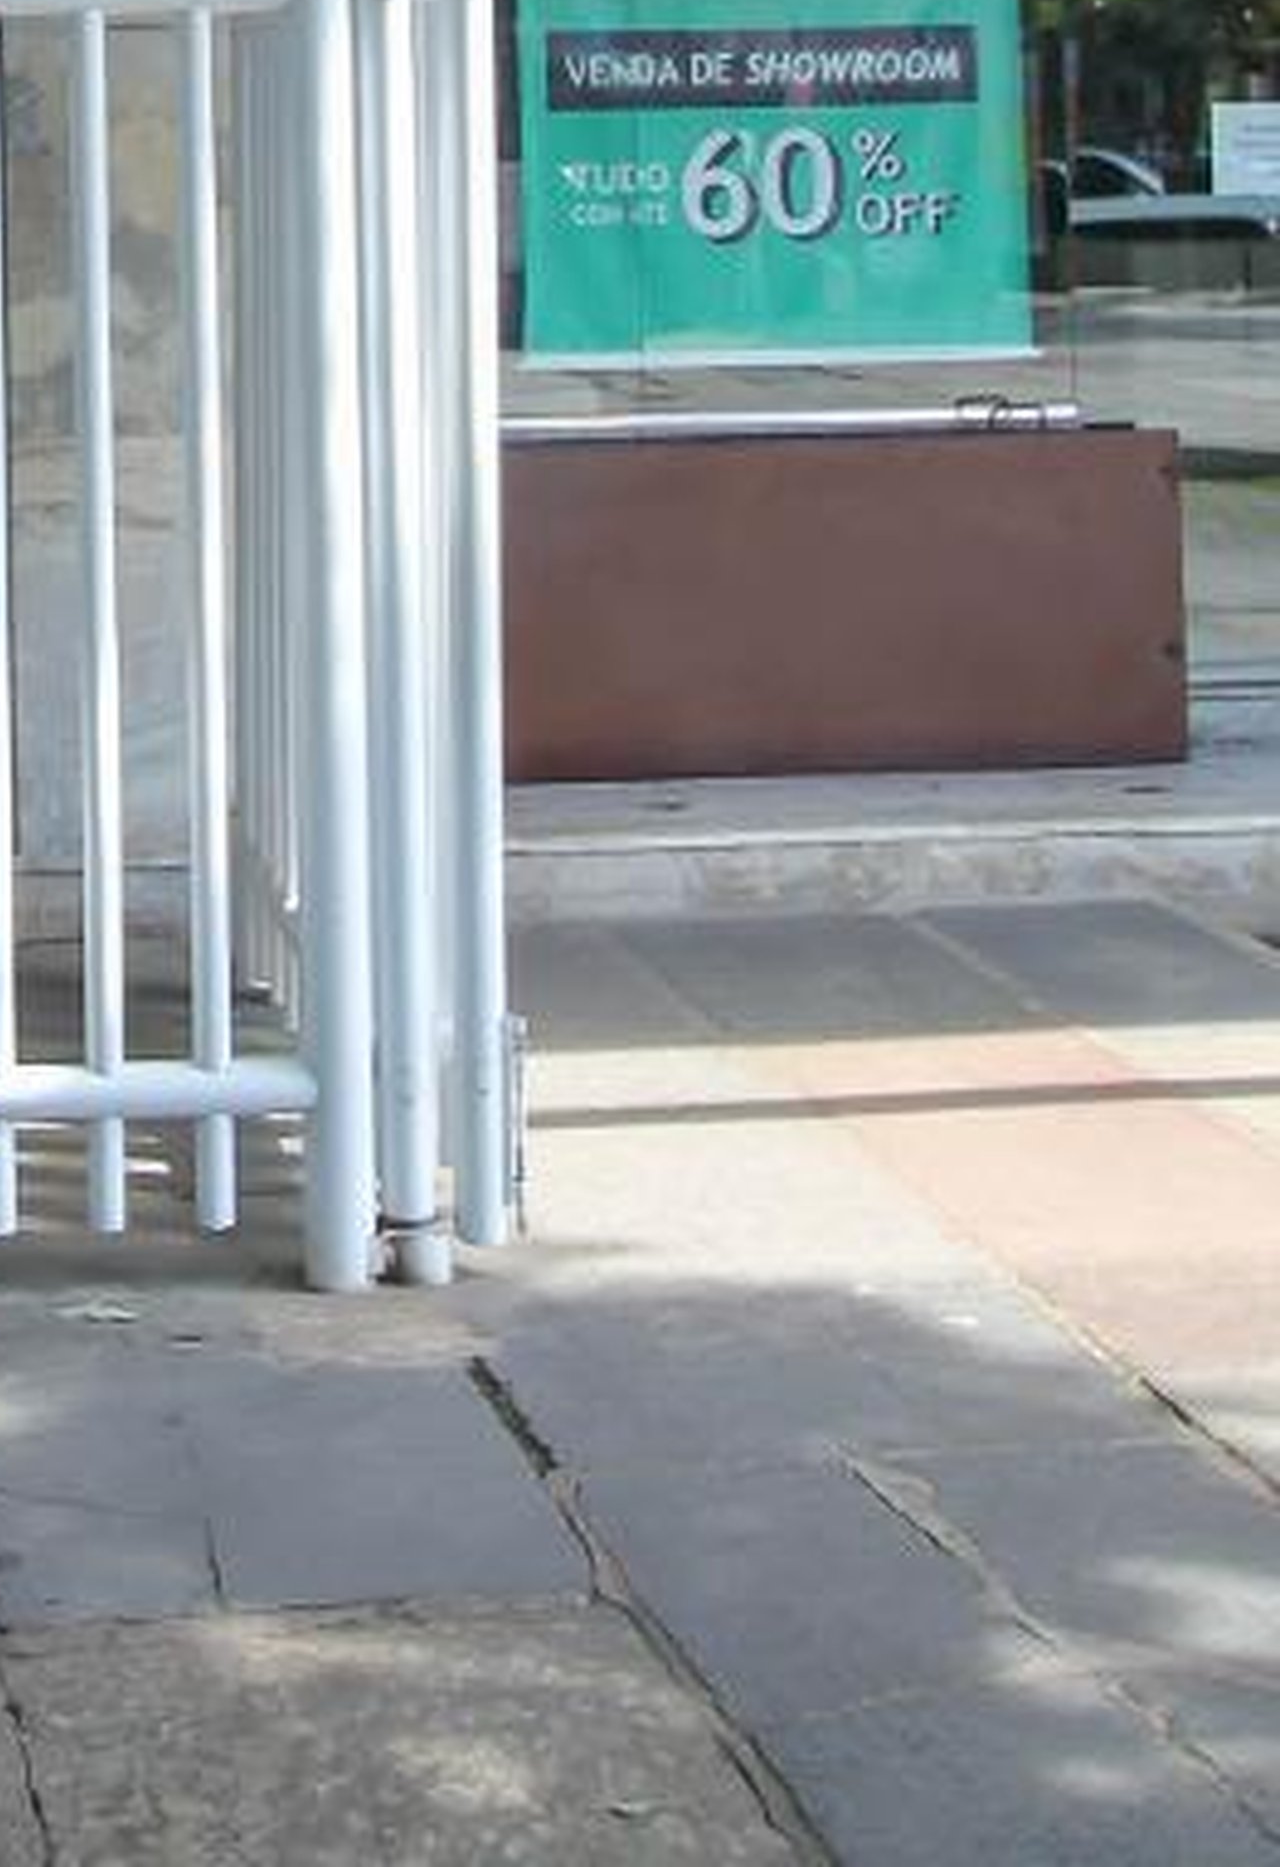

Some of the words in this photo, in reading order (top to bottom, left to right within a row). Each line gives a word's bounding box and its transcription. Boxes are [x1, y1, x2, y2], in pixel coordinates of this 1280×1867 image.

[565, 51, 680, 87] VENDA
[689, 52, 733, 85] DE
[744, 47, 962, 86] SHOWROOM
[855, 192, 958, 236] OFF
